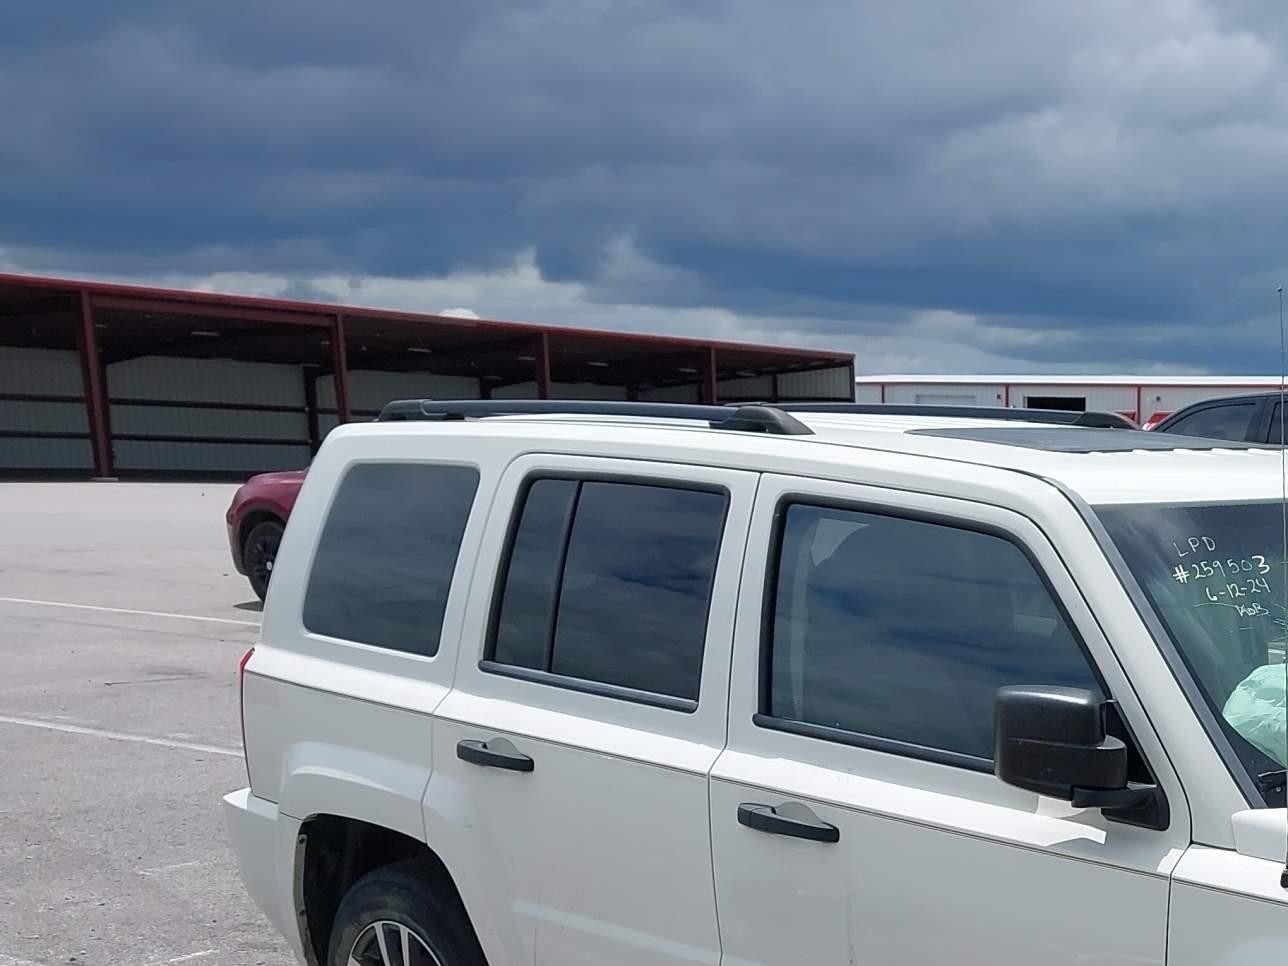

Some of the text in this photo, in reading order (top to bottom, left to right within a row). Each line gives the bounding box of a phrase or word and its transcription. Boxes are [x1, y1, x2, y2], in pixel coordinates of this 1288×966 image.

[1173, 536, 1216, 557] LPD
[1172, 555, 1271, 584] #259503
[1205, 577, 1271, 601] 6-12-24
